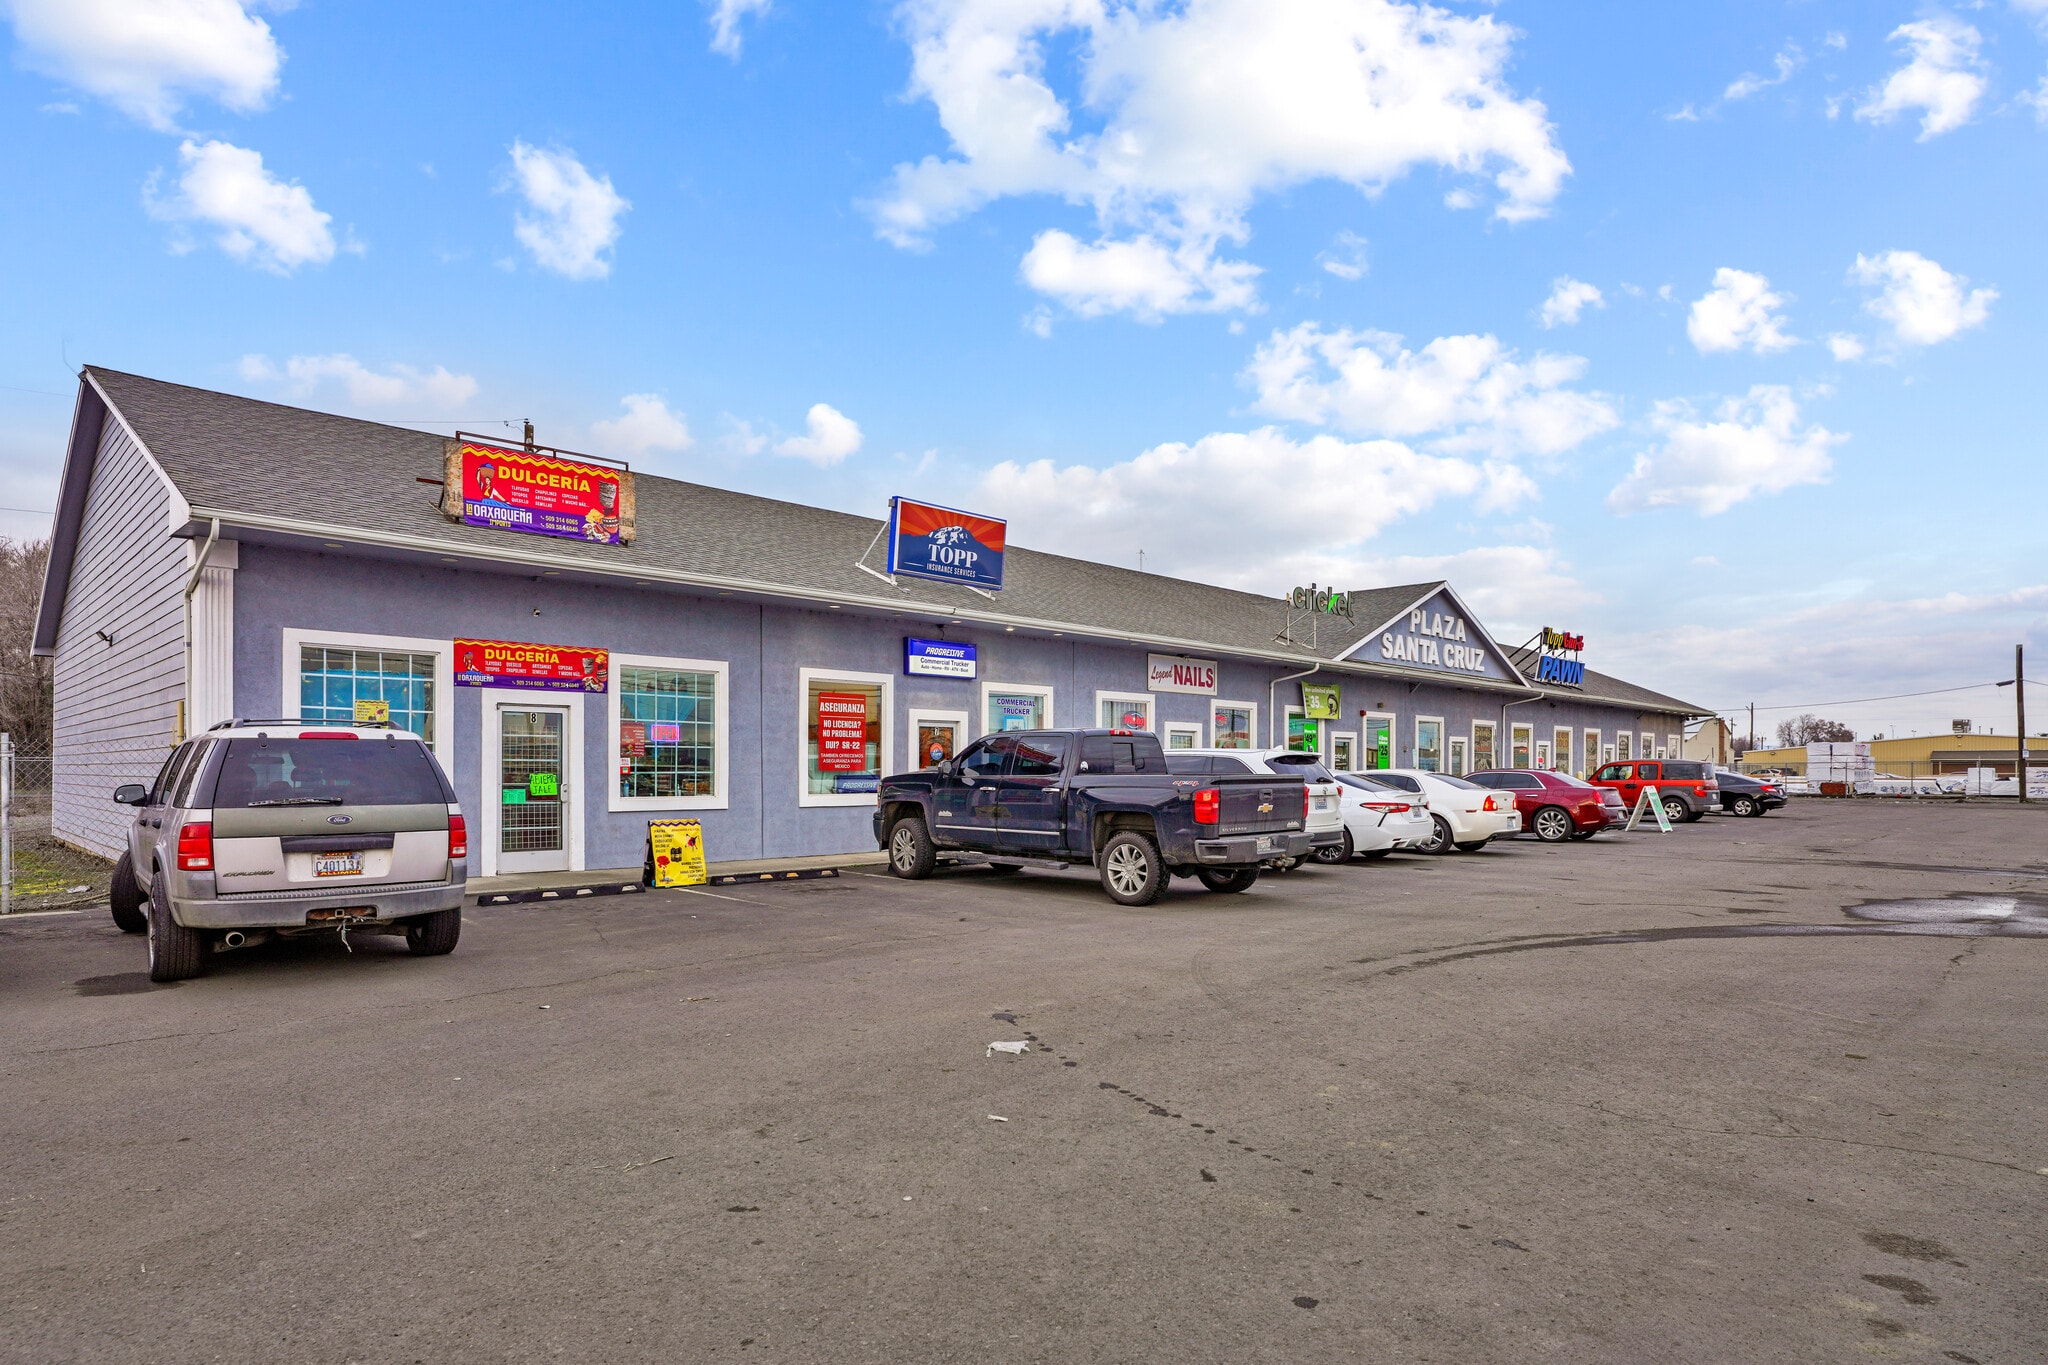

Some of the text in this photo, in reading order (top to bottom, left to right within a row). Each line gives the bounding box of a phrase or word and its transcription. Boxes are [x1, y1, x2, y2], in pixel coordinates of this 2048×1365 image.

[498, 466, 591, 492] DULCERÍA
[474, 504, 533, 524] OAXAQUEÑA
[928, 544, 978, 568] TOPP
[927, 563, 976, 578] INSURANCE SERVICES
[1293, 583, 1353, 618] cricket
[1409, 608, 1466, 642] PLAZA
[484, 649, 560, 664] DULCERÍA
[925, 647, 965, 657] PROGRESSIVE
[1382, 632, 1485, 672] SANTA CRUZ
[920, 657, 950, 666] Commercial
[1151, 664, 1213, 688] Legend NAILS
[1540, 656, 1585, 685] PAWN
[820, 702, 865, 714] ASEGURANZA
[997, 699, 1035, 707] COMMERCIAL
[532, 713, 536, 723] 8
[824, 720, 861, 728] NO LICENCIA?
[822, 729, 862, 738] NO PROBLEMA!
[826, 741, 860, 750] DUI? SR-22
